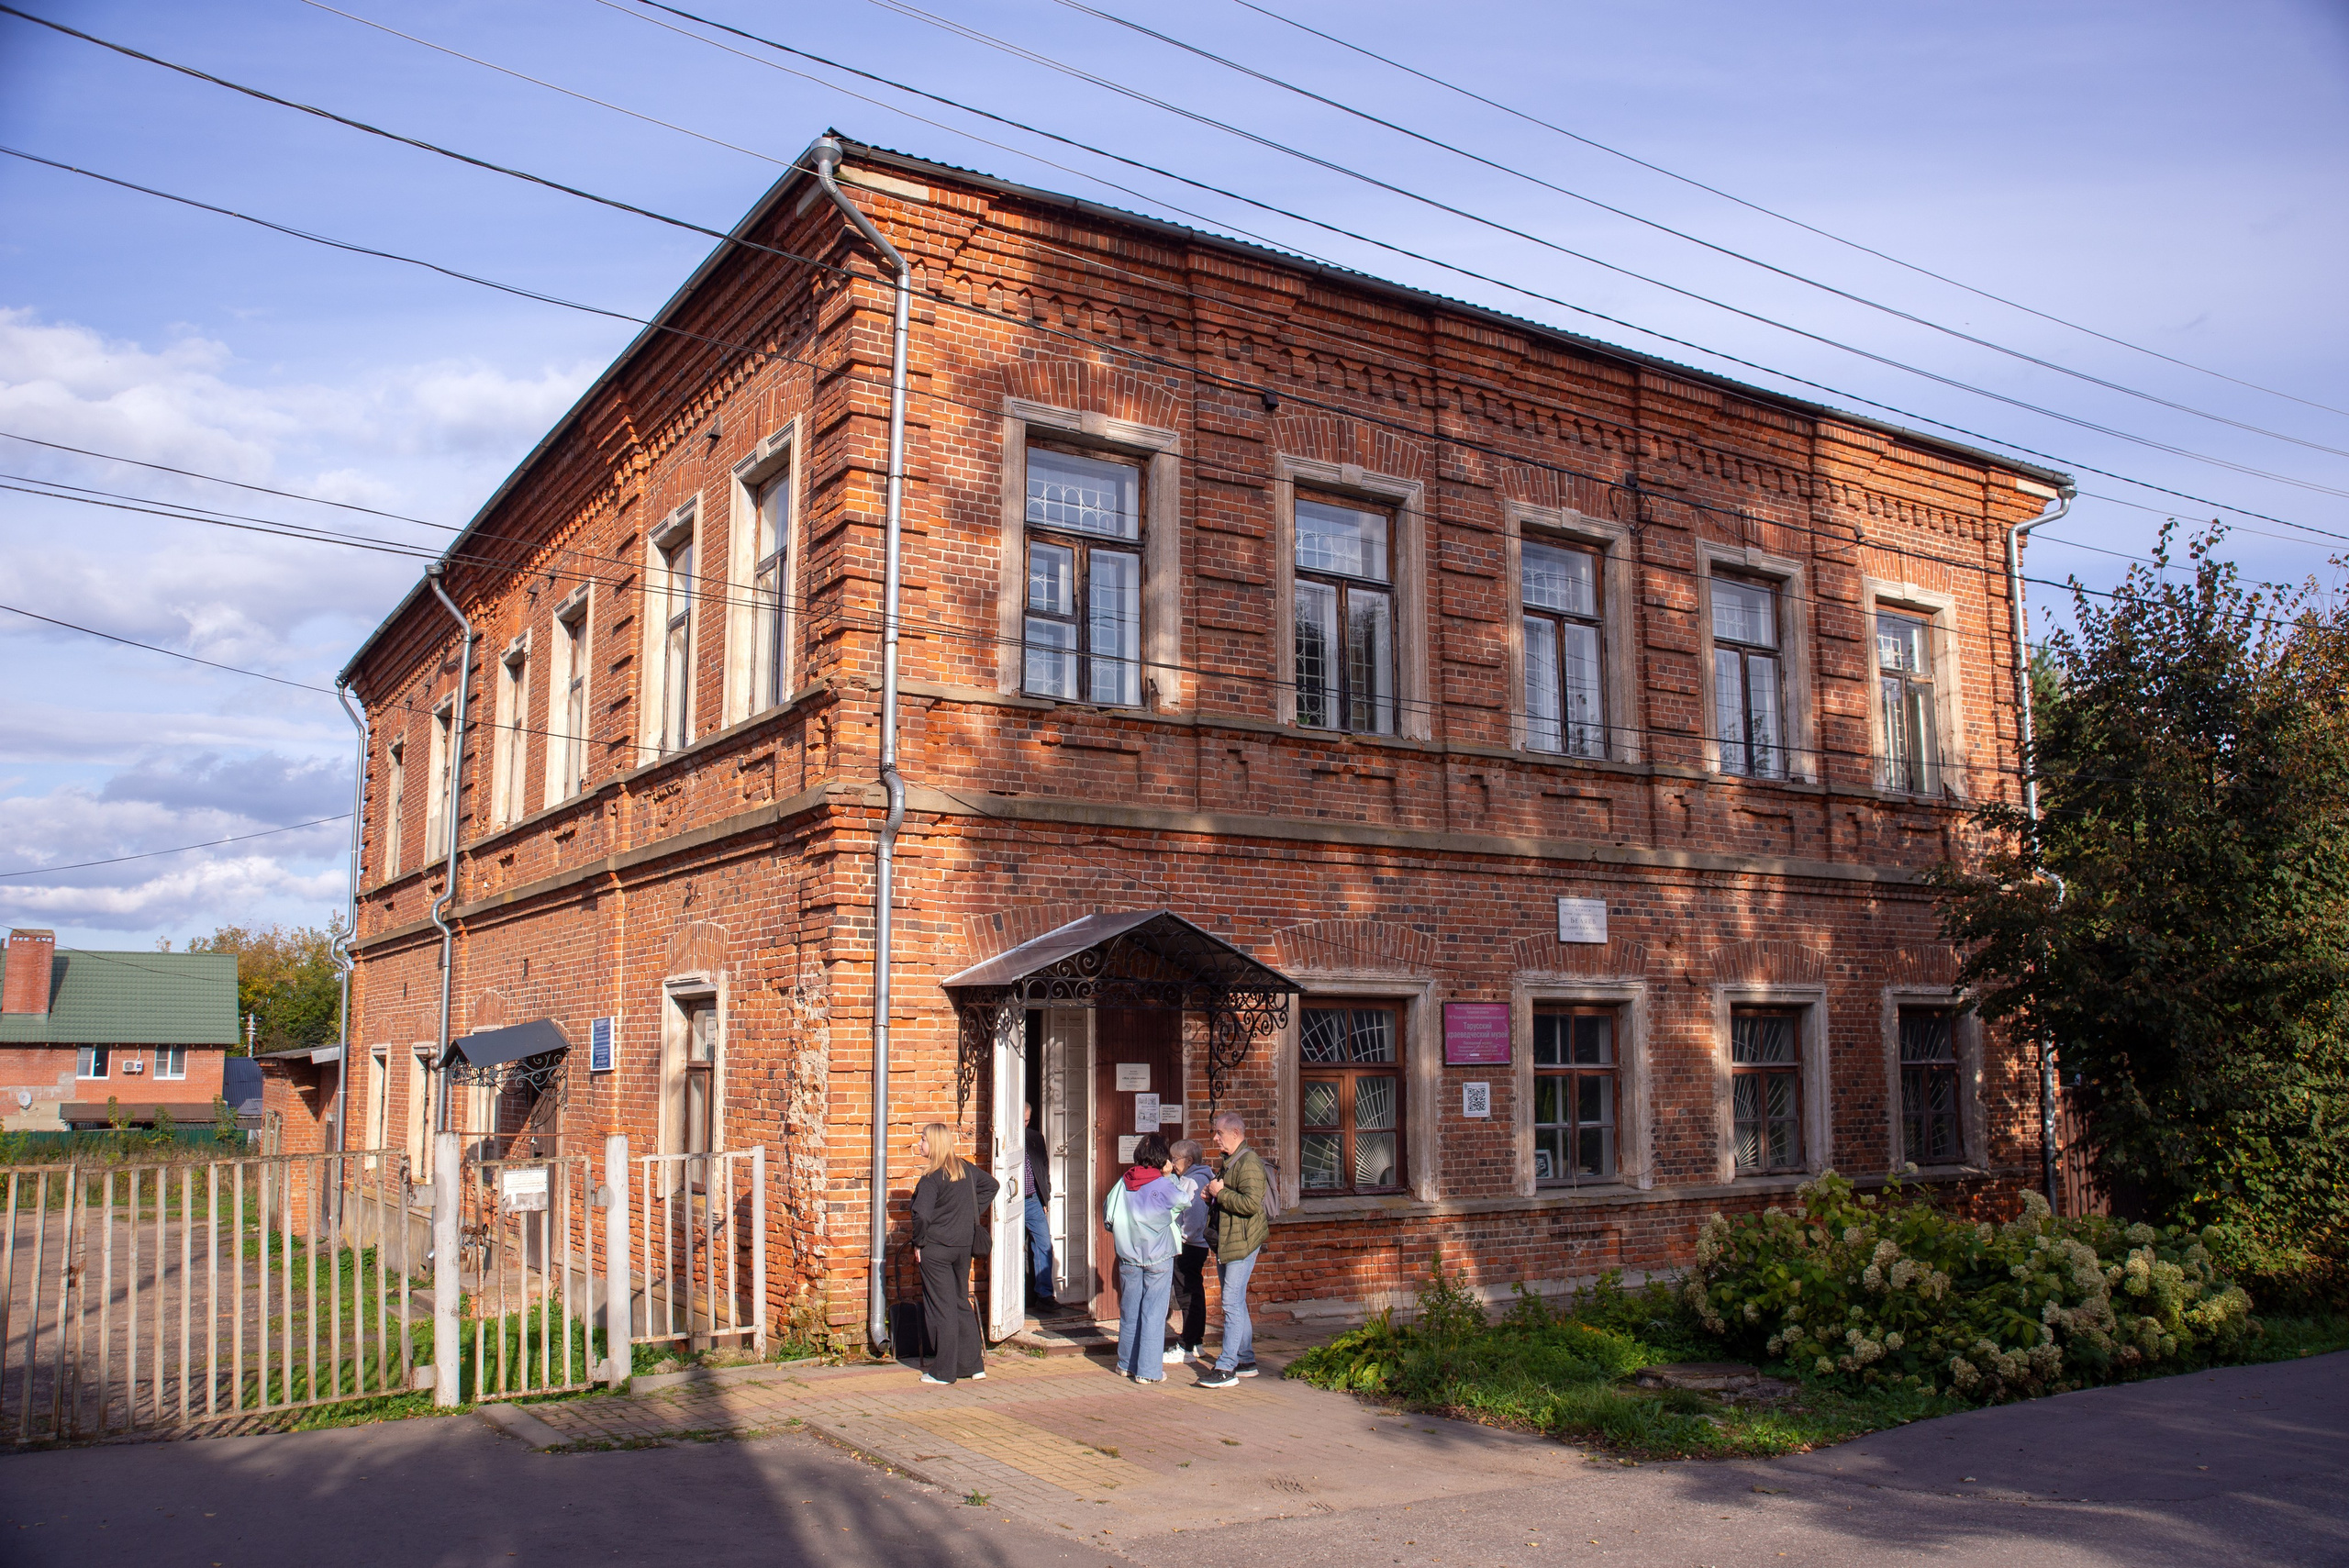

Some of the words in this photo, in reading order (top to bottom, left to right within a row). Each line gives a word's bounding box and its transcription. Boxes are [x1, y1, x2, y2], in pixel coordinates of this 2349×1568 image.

[1463, 1021, 1493, 1031] Тарусский
[1447, 1030, 1490, 1040] краеведческий
[1490, 1030, 1508, 1040] музей
